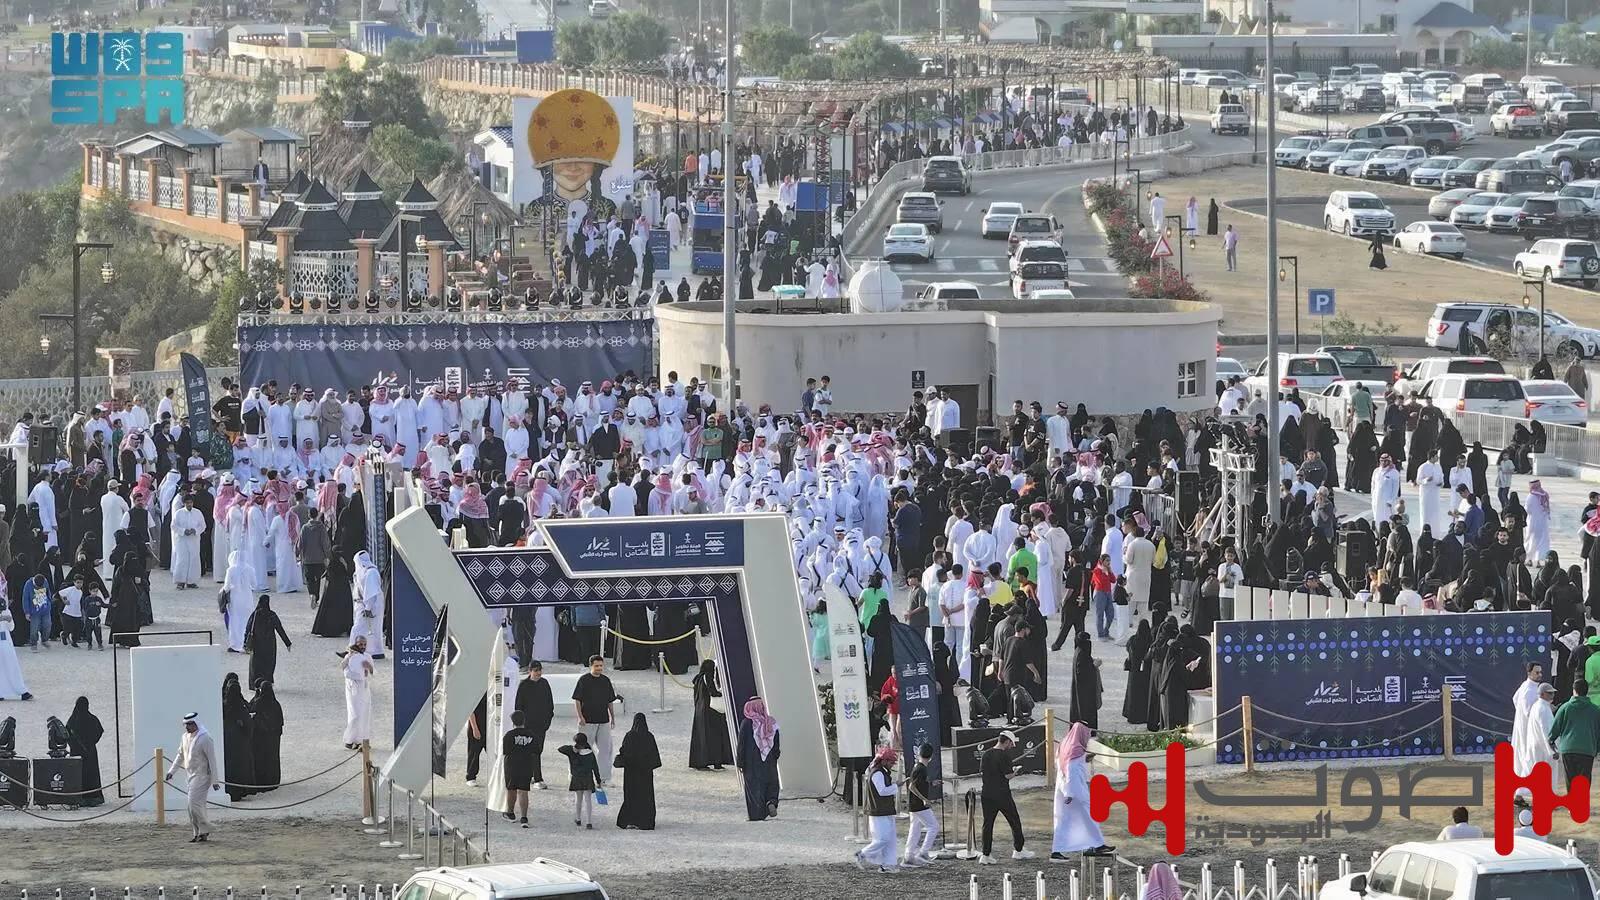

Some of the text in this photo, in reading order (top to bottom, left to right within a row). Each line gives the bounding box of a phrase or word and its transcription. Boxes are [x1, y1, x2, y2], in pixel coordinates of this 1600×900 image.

[1316, 294, 1330, 312] P
[625, 541, 649, 549] بلدية
[401, 657, 415, 666] عليه
[1356, 684, 1382, 695] بلدية
